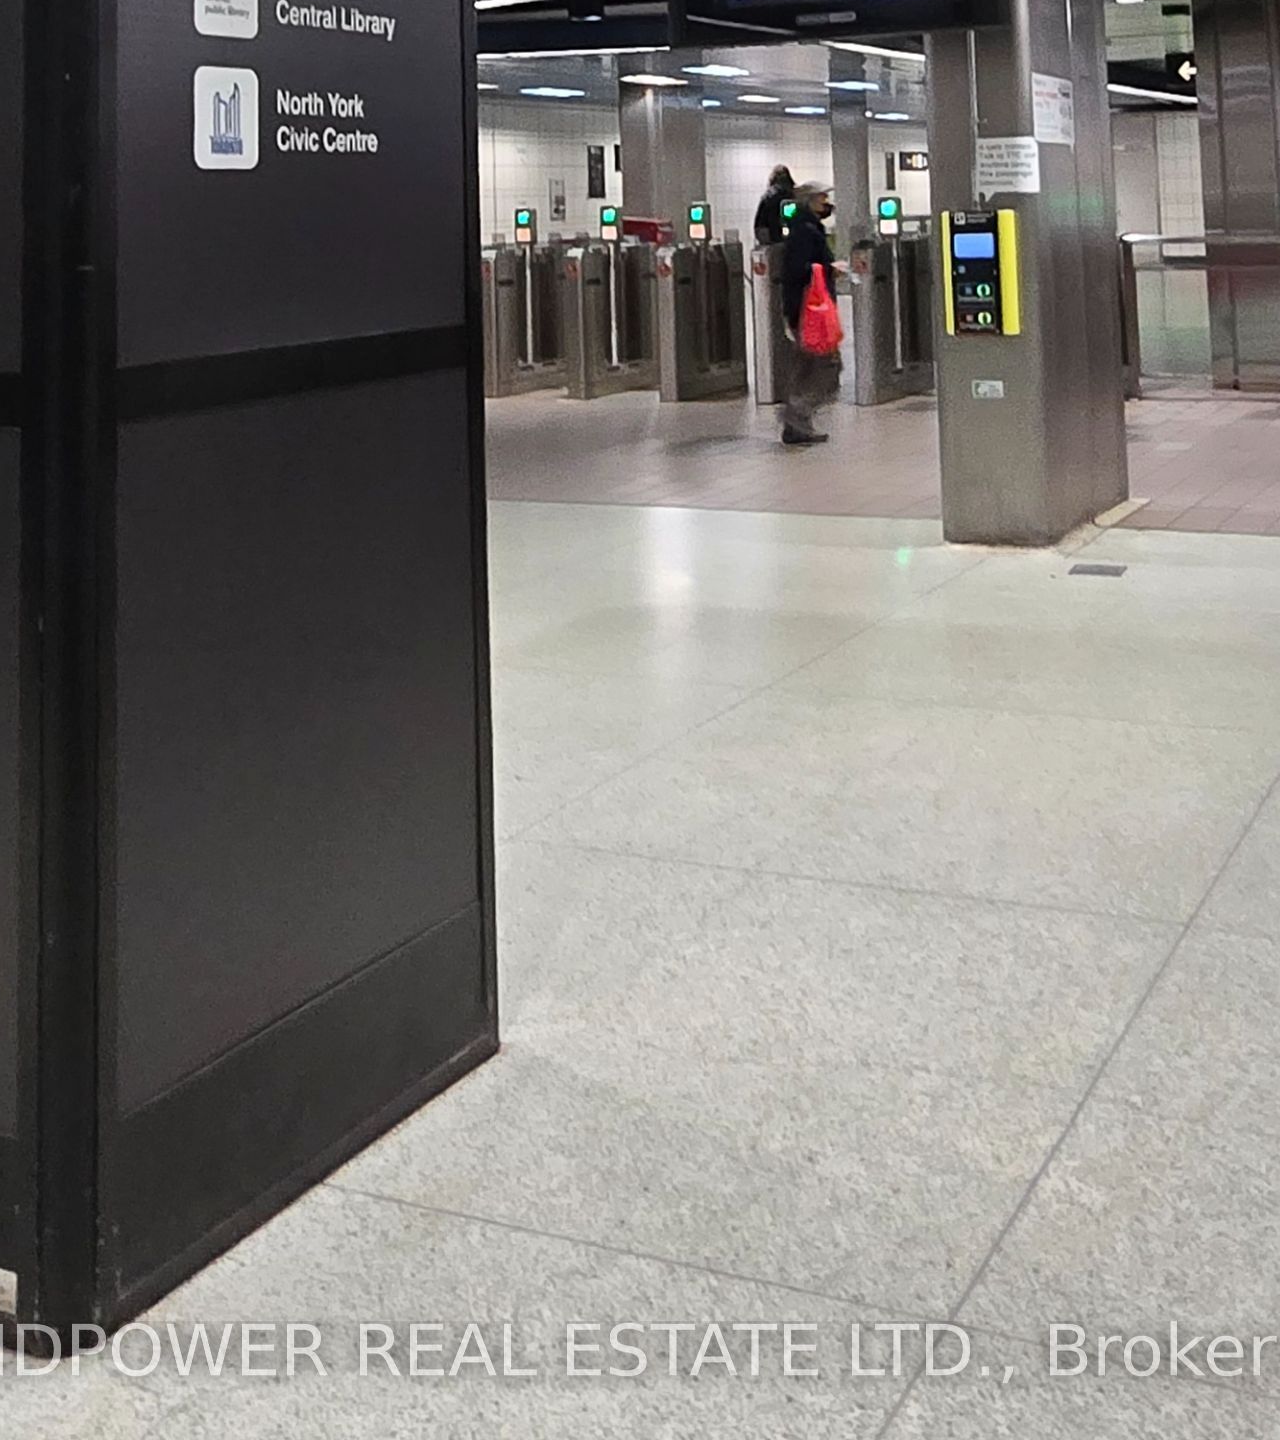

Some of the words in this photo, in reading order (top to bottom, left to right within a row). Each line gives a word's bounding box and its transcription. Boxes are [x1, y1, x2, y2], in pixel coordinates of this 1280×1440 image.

[276, 0, 337, 29] Central
[340, 6, 396, 41] Library
[276, 89, 324, 117] North
[326, 92, 365, 118] York
[276, 126, 320, 152] Civic
[323, 126, 379, 154] Centre
